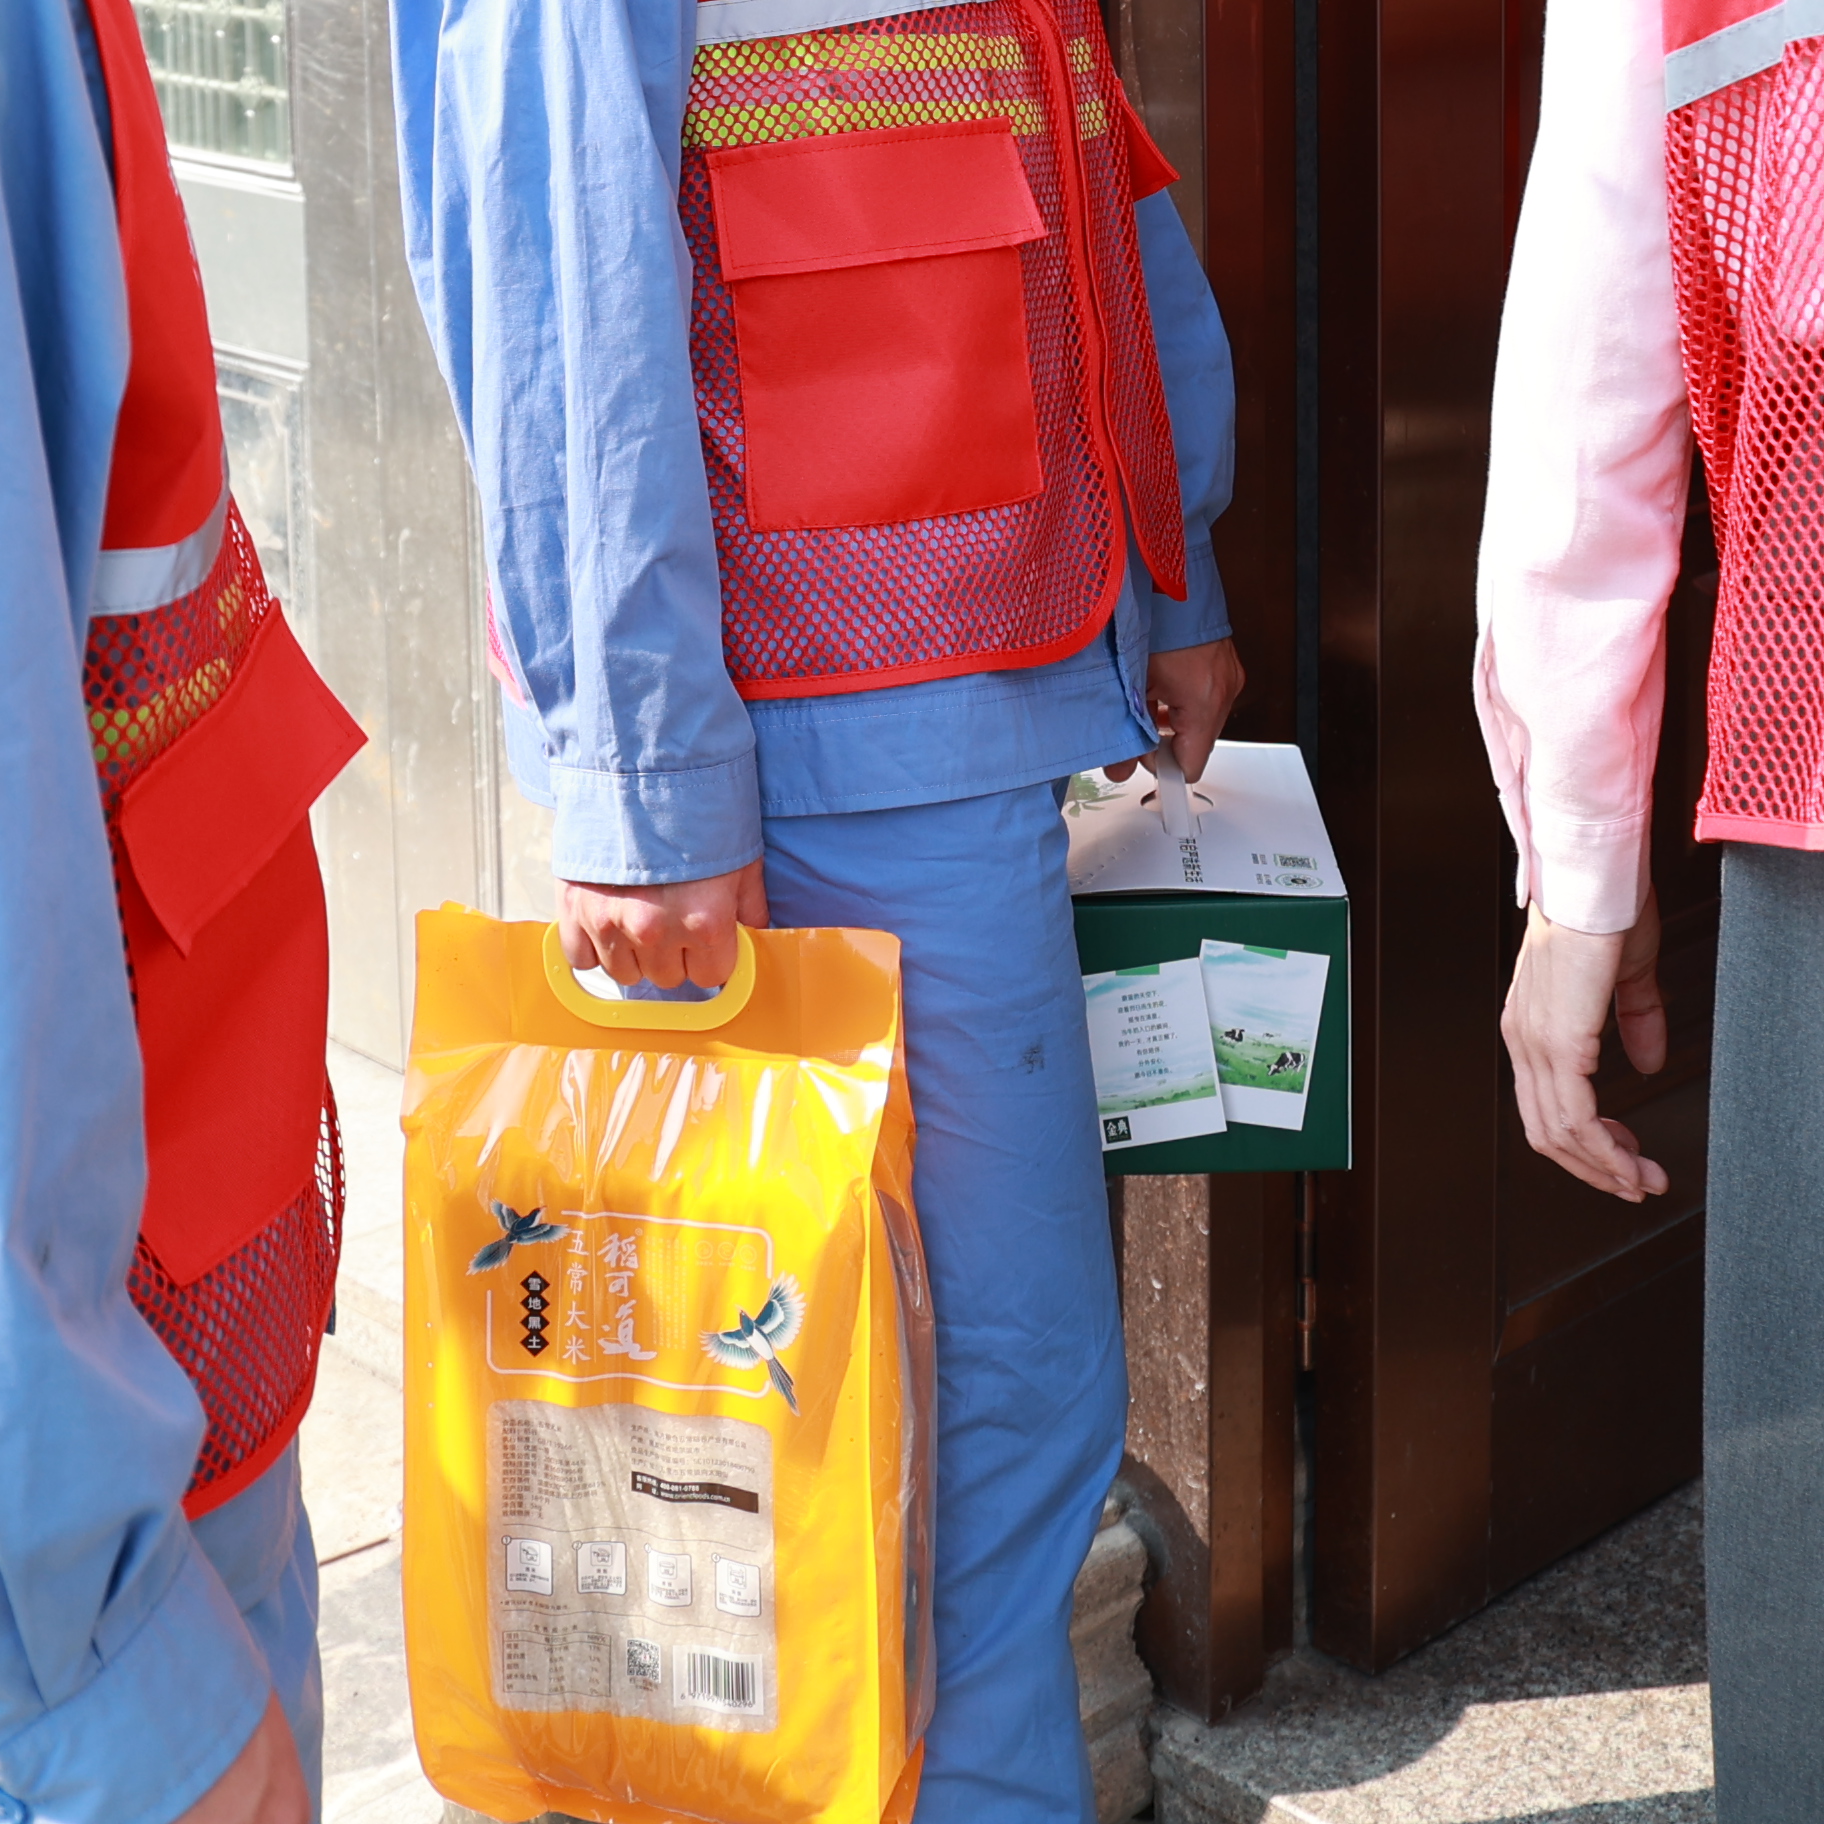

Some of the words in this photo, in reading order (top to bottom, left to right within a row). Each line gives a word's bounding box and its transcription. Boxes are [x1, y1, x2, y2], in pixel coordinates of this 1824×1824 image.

[1106, 1119, 1128, 1137] 金典
[527, 1277, 542, 1349] 雪地黑土
[562, 1229, 591, 1365] 五常大米
